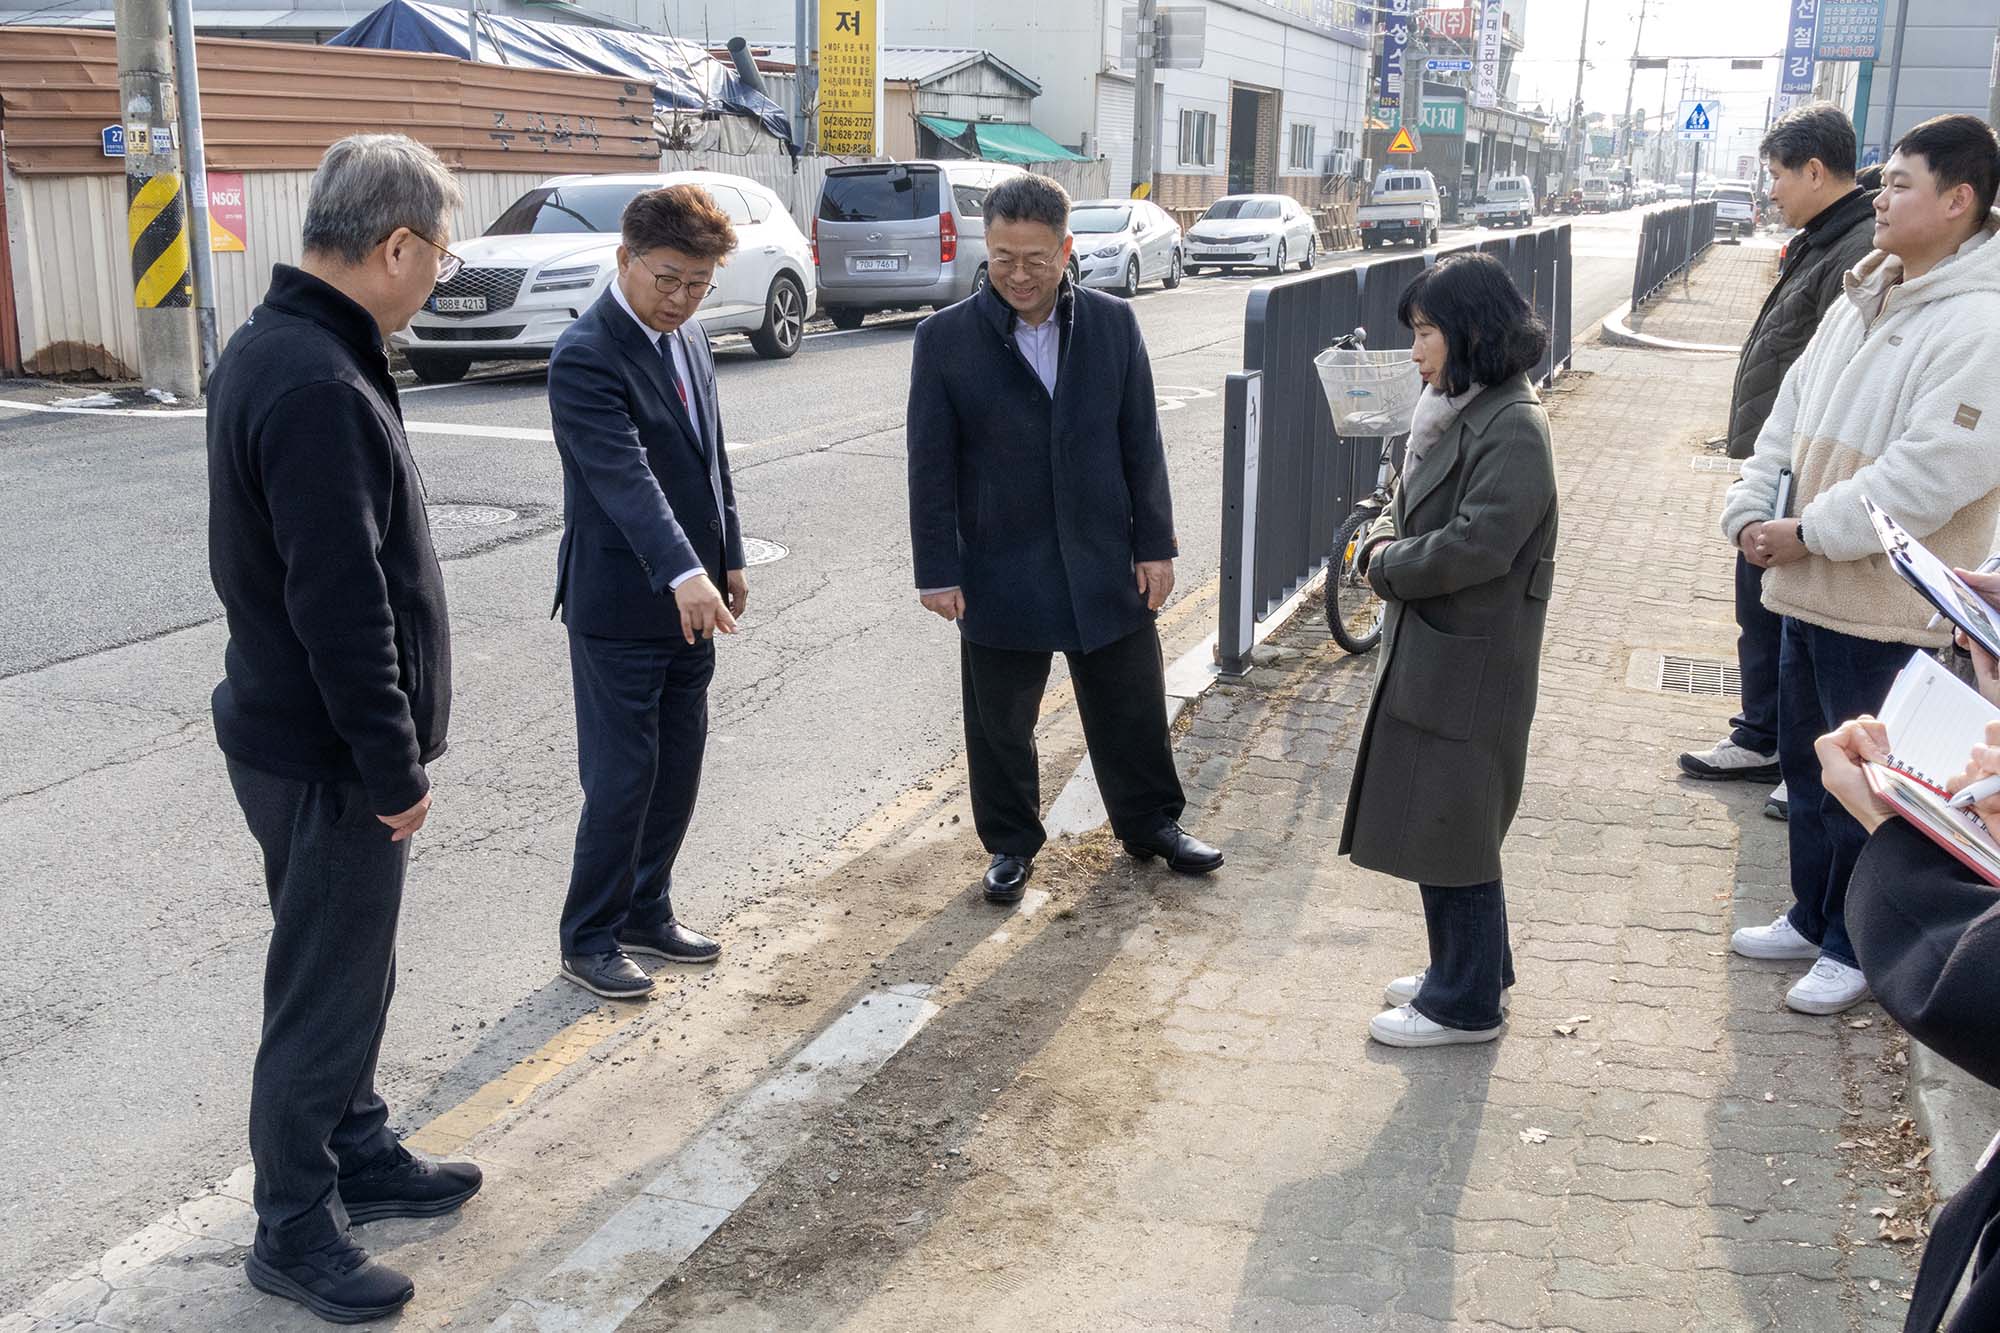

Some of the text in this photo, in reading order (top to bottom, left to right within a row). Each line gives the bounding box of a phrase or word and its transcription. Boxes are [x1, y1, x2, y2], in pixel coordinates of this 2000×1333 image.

[835, 0, 860, 36] 져
[212, 191, 241, 206] NSOK
[462, 298, 485, 310] 4213
